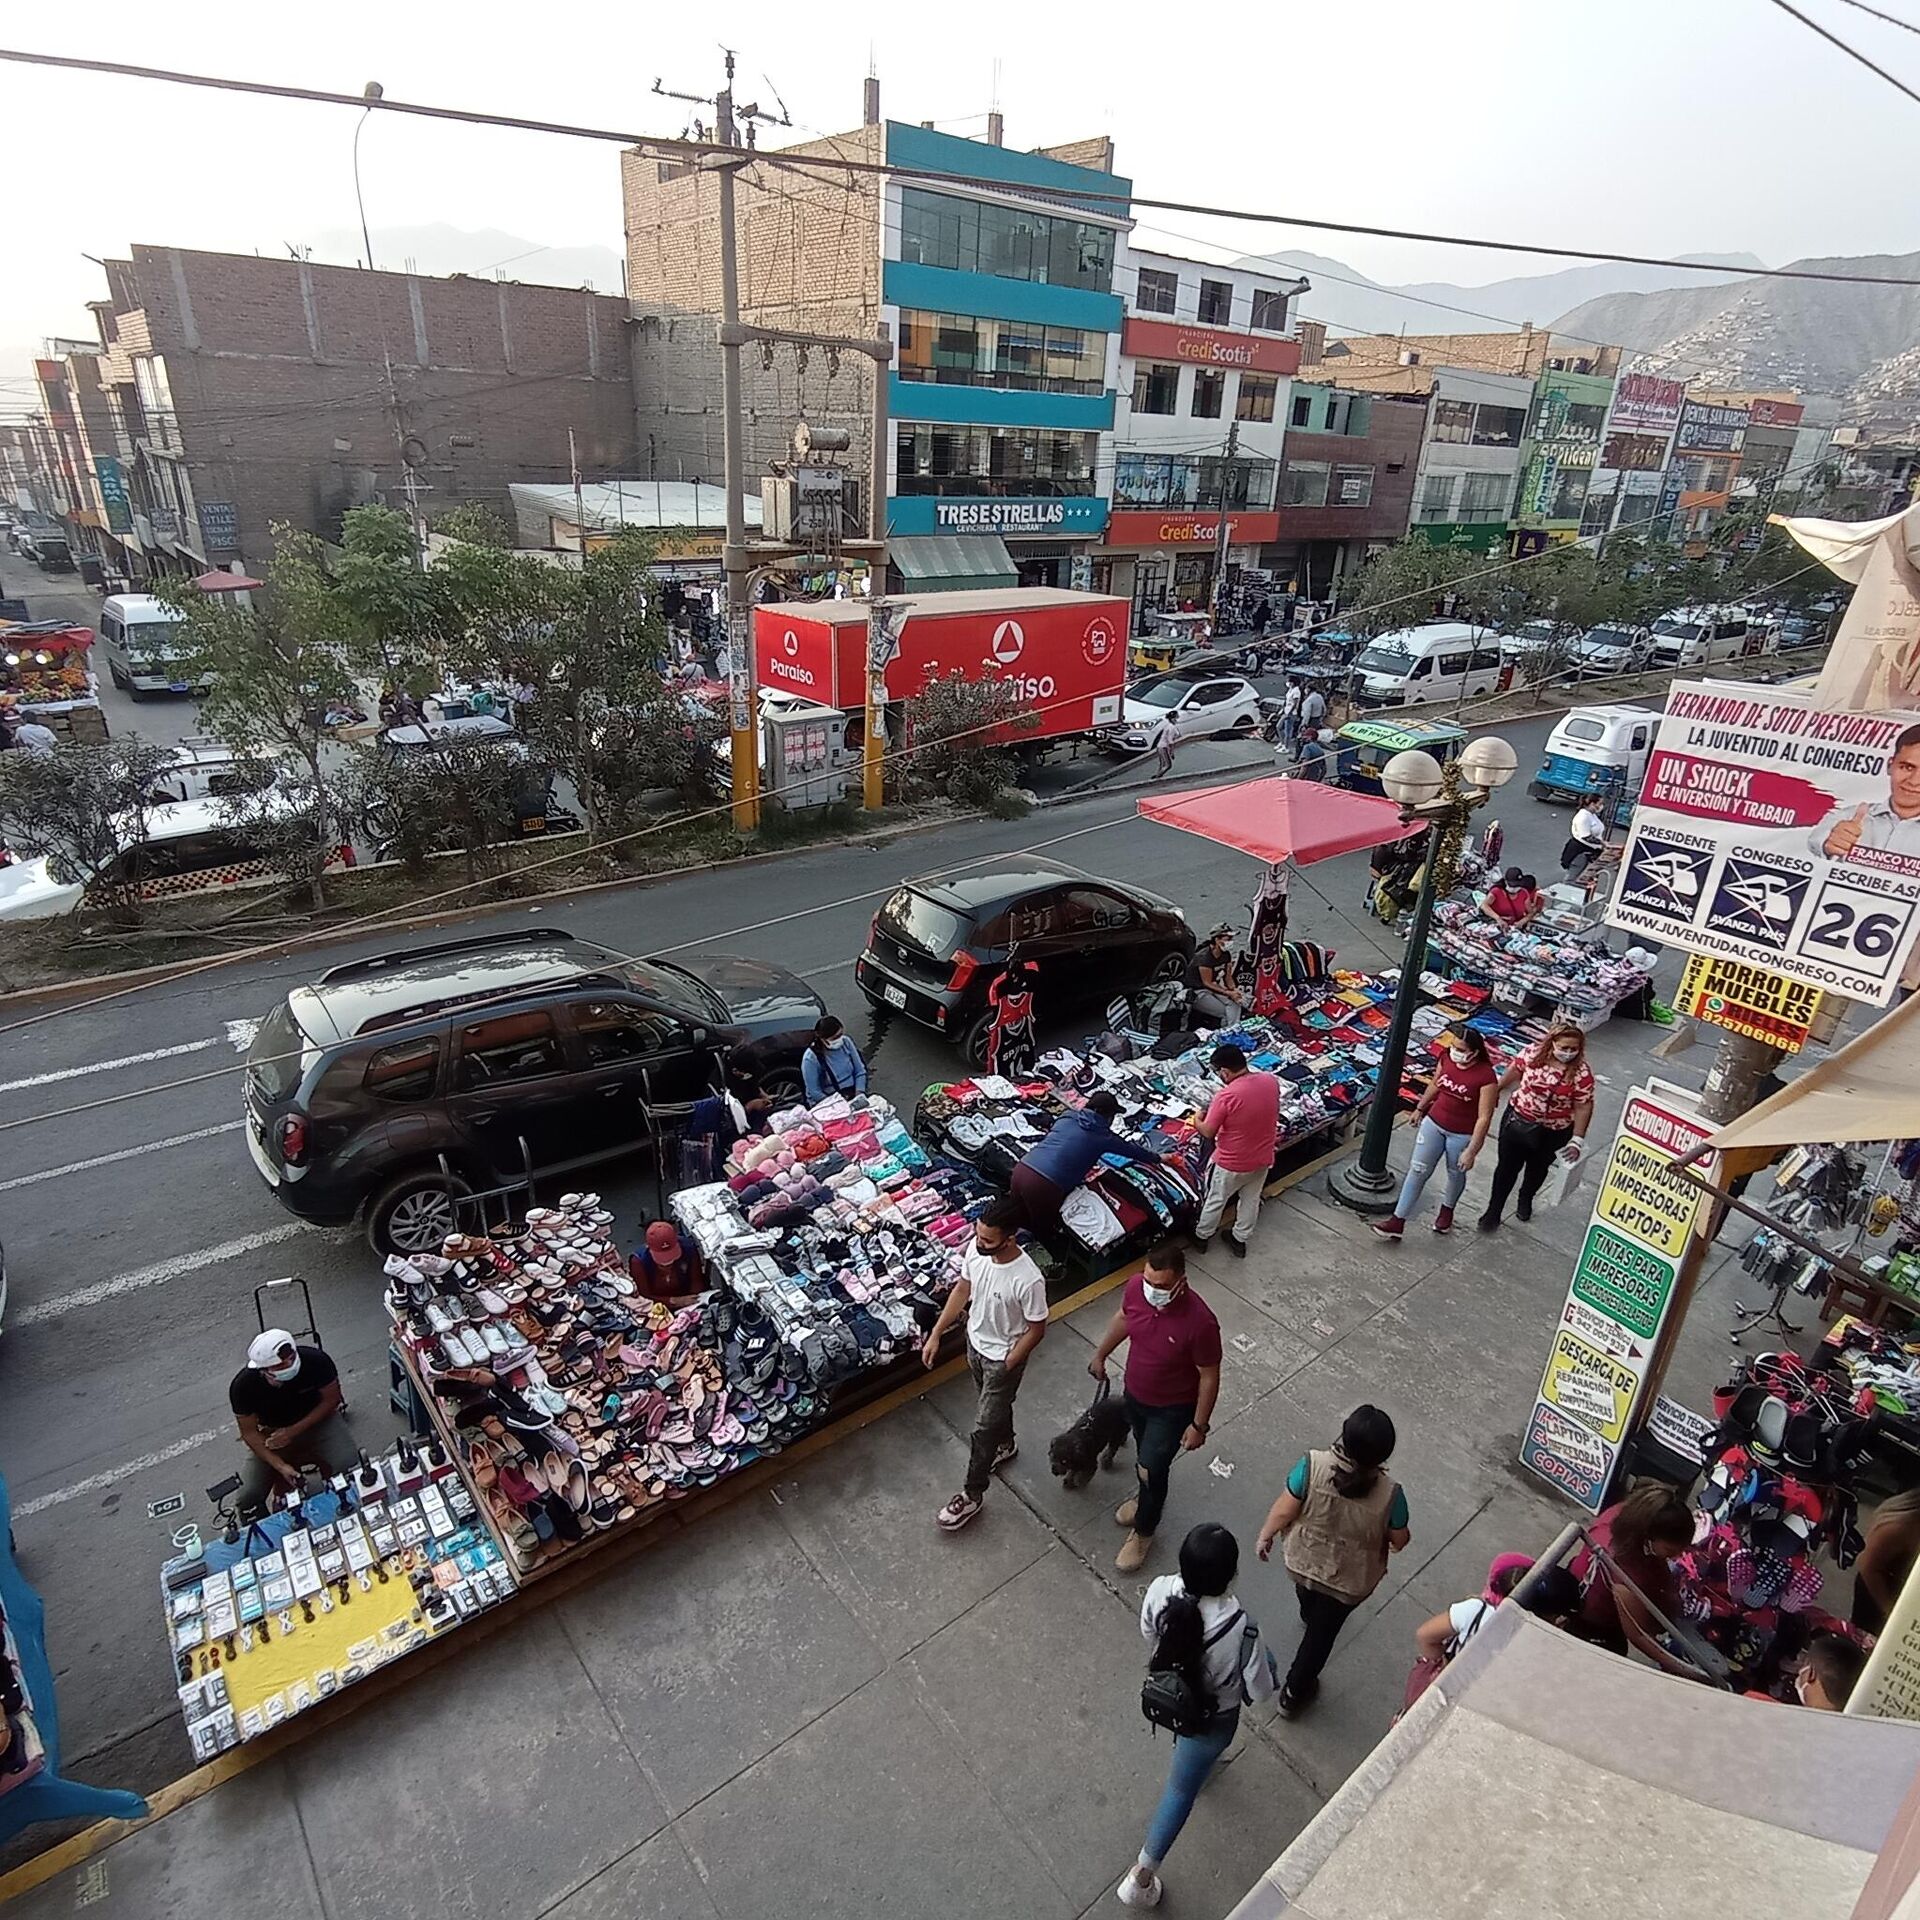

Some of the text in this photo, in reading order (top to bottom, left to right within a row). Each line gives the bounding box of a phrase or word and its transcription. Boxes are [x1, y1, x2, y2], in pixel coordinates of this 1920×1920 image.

[1177, 338, 1252, 364] CrediScotia
[1667, 691, 1904, 750] HERNANDO DE SOTO PRESIDENTE
[1686, 726, 1885, 776] LA JUVENTUD AL CONGRESO
[1657, 757, 1755, 797] UN SHOCK
[1652, 784, 1796, 826] DE INVERSIÓN Y TRABAJO
[1639, 824, 1718, 851] PRESIDENTE
[1731, 845, 1814, 873] CONGRESO
[1850, 846, 1902, 865] FRANCO
[1622, 889, 1666, 909] AVANZA
[1828, 867, 1892, 892] ESCRIBE
[1709, 914, 1757, 937] AVANZA
[1808, 902, 1902, 958] 26
[1615, 909, 1883, 998] WWW.JUVENTUDALCONGRESO.COM
[1704, 975, 1812, 1025] MUEBLES
[1709, 958, 1820, 1008] FORRO DE
[1701, 1011, 1800, 1054] 925706068
[1626, 1103, 1672, 1143] SERVICIO
[1615, 1144, 1698, 1203] COMPUTADORAS
[1609, 1170, 1690, 1223] IMPRESORAS
[1608, 1198, 1673, 1246] LAPTOP'S
[1593, 1232, 1666, 1285] TINTAS PARA
[1585, 1254, 1660, 1308] IMPRESORAS
[1559, 1337, 1614, 1383] DESCARGA
[1614, 1371, 1634, 1394] DE
[1558, 1392, 1613, 1419] COMPUTADORAS
[1656, 1397, 1686, 1422] SERVICIO
[1535, 1451, 1590, 1496] COPIAS
